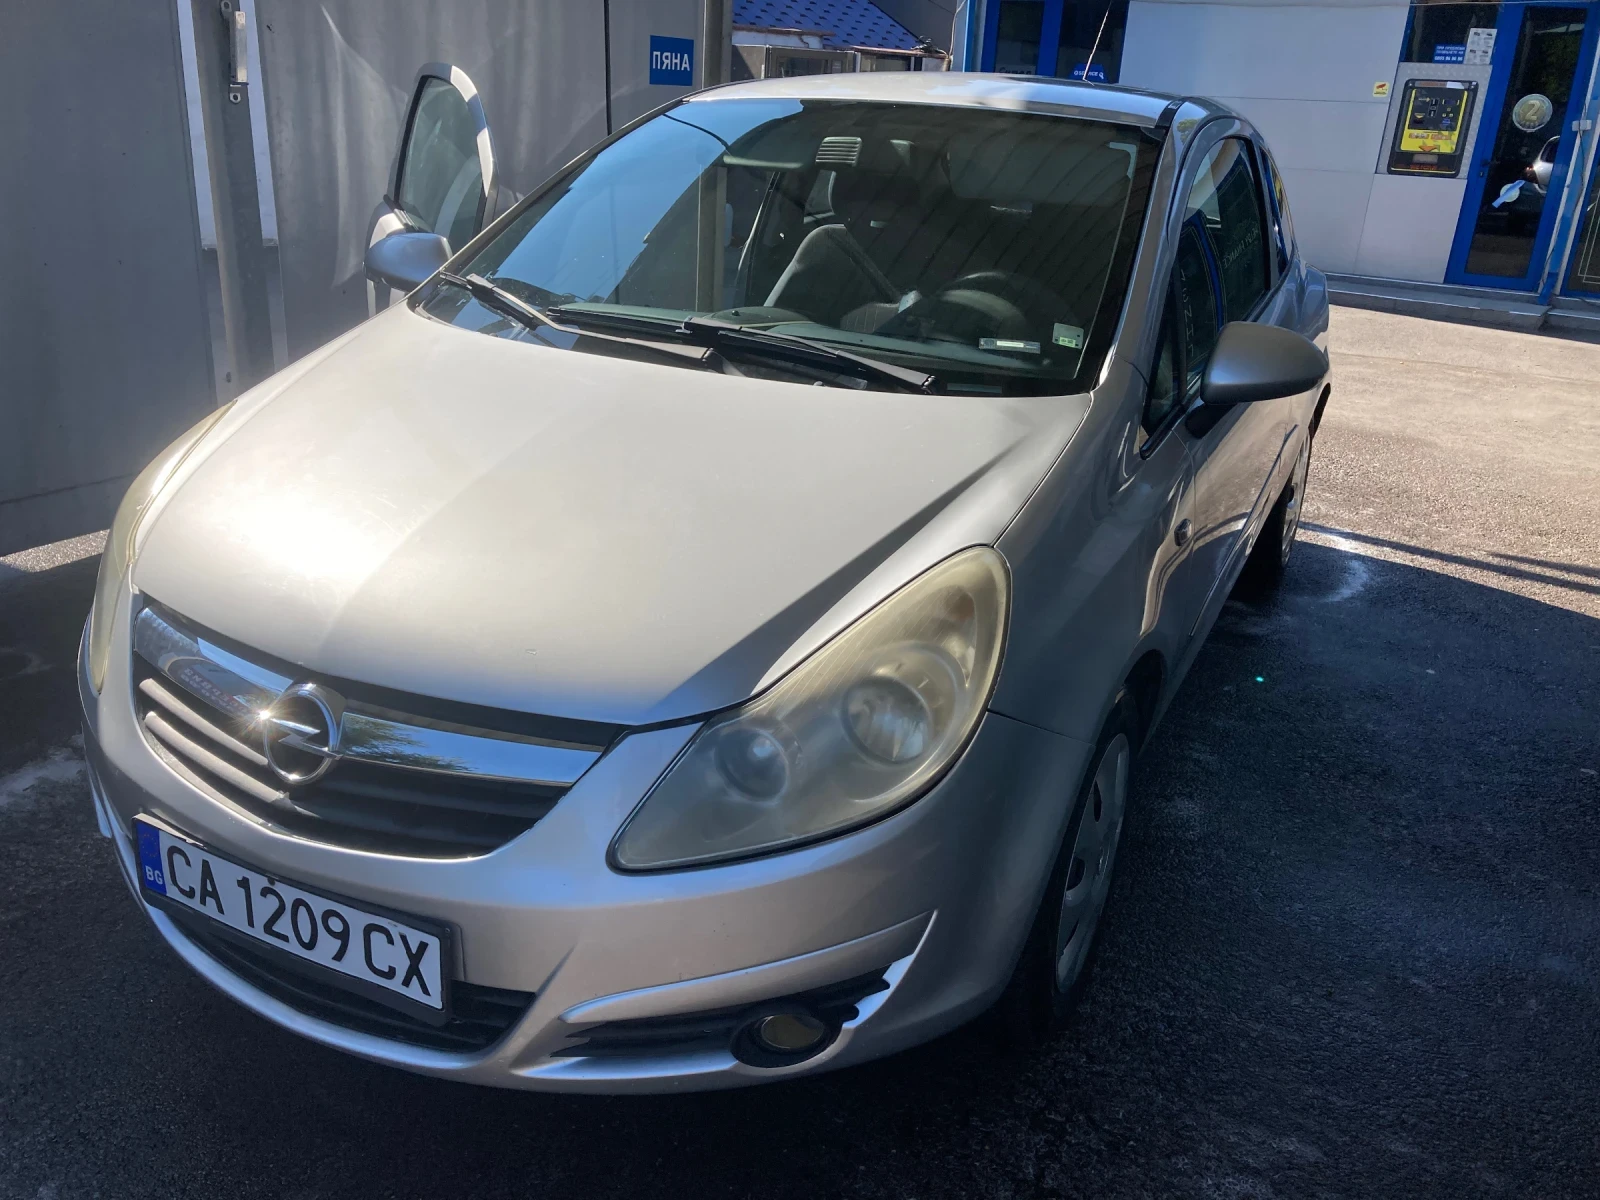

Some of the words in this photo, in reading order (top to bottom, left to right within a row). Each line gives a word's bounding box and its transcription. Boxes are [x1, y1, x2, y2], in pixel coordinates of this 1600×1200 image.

[652, 51, 690, 71] ПЯНА
[145, 865, 163, 885] BG
[166, 845, 225, 915] CA
[236, 876, 350, 962] 1209
[363, 923, 431, 997] CX
